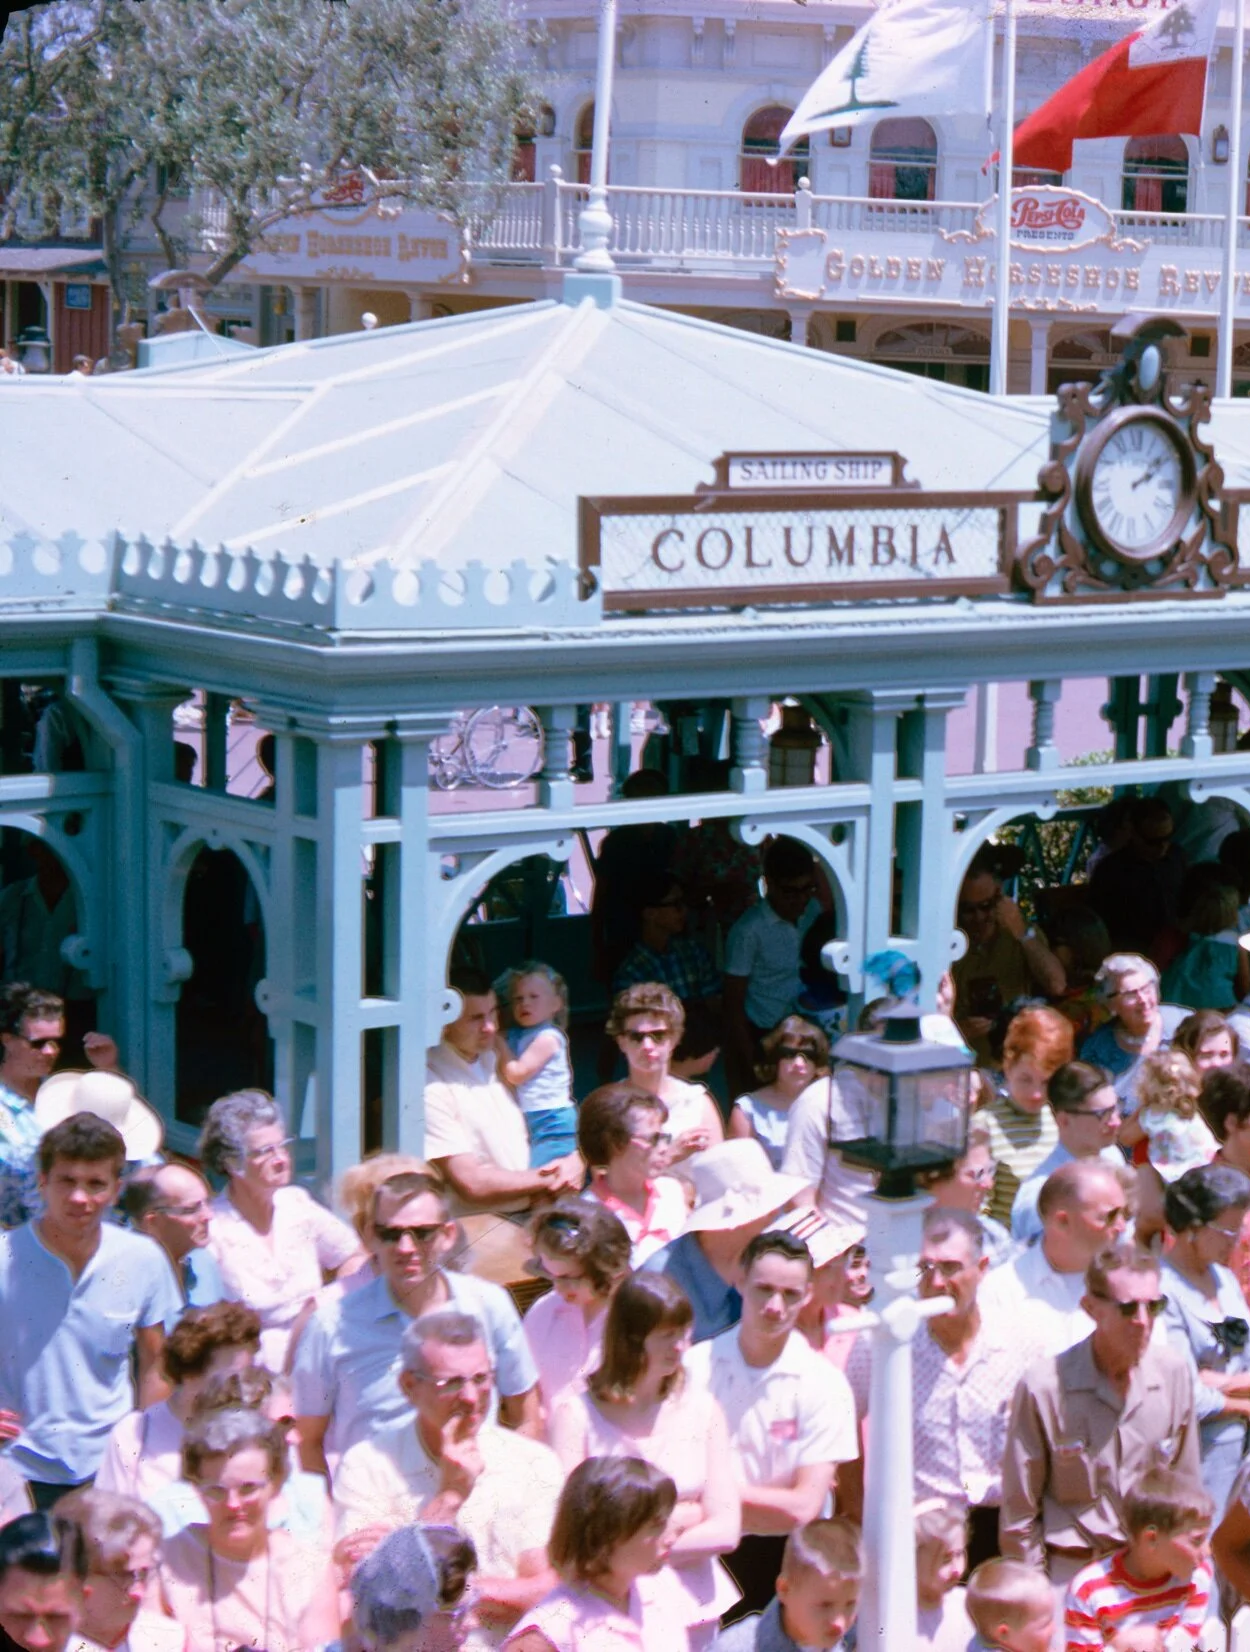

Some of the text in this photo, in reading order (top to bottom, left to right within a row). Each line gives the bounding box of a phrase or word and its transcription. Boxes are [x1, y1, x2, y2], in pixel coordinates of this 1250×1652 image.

[1016, 229, 1075, 241] PRESENTS
[825, 249, 946, 281] GOLDEN
[740, 460, 883, 481] SAILING SHIP
[651, 523, 957, 573] COLUMBIA
